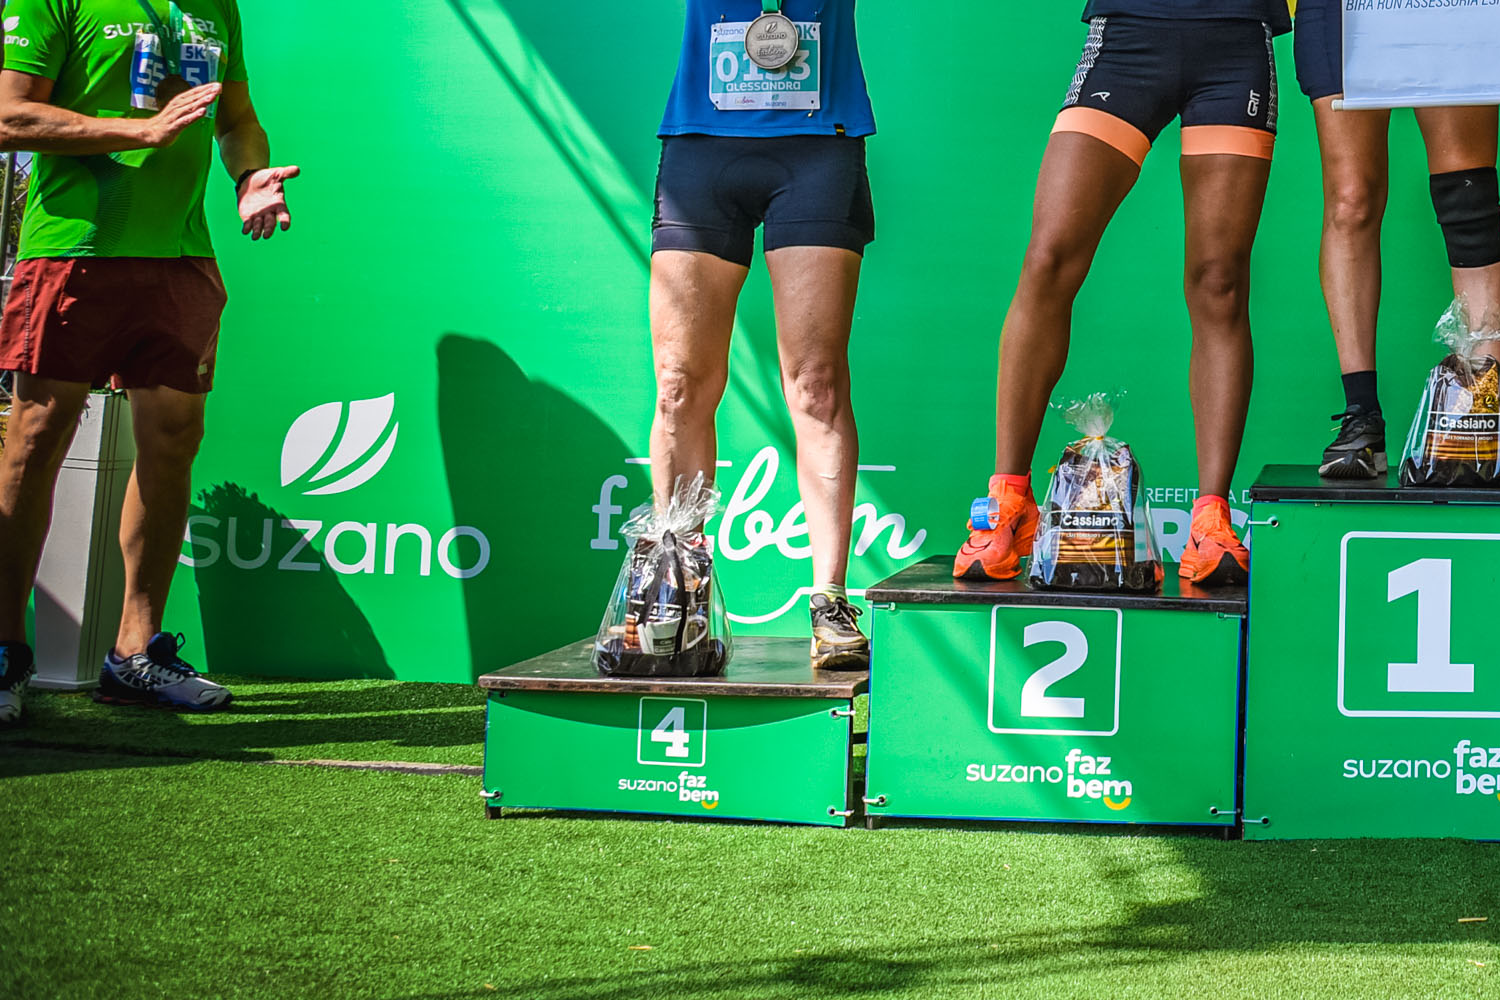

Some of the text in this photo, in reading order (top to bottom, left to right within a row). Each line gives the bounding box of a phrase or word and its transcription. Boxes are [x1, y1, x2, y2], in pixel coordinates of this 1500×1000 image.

[185, 46, 206, 60] 5K
[1439, 416, 1496, 430] Cassiano
[1062, 514, 1119, 527] Cassiano
[178, 515, 491, 579] suzano
[1386, 557, 1475, 693] 1
[1020, 620, 1089, 719] 2
[651, 706, 690, 758] 4
[966, 748, 1112, 784] suzano faz
[1342, 758, 1451, 779] suzano
[617, 770, 707, 793] suzano faz
[678, 785, 719, 802] bem
[1066, 774, 1133, 799] bem
